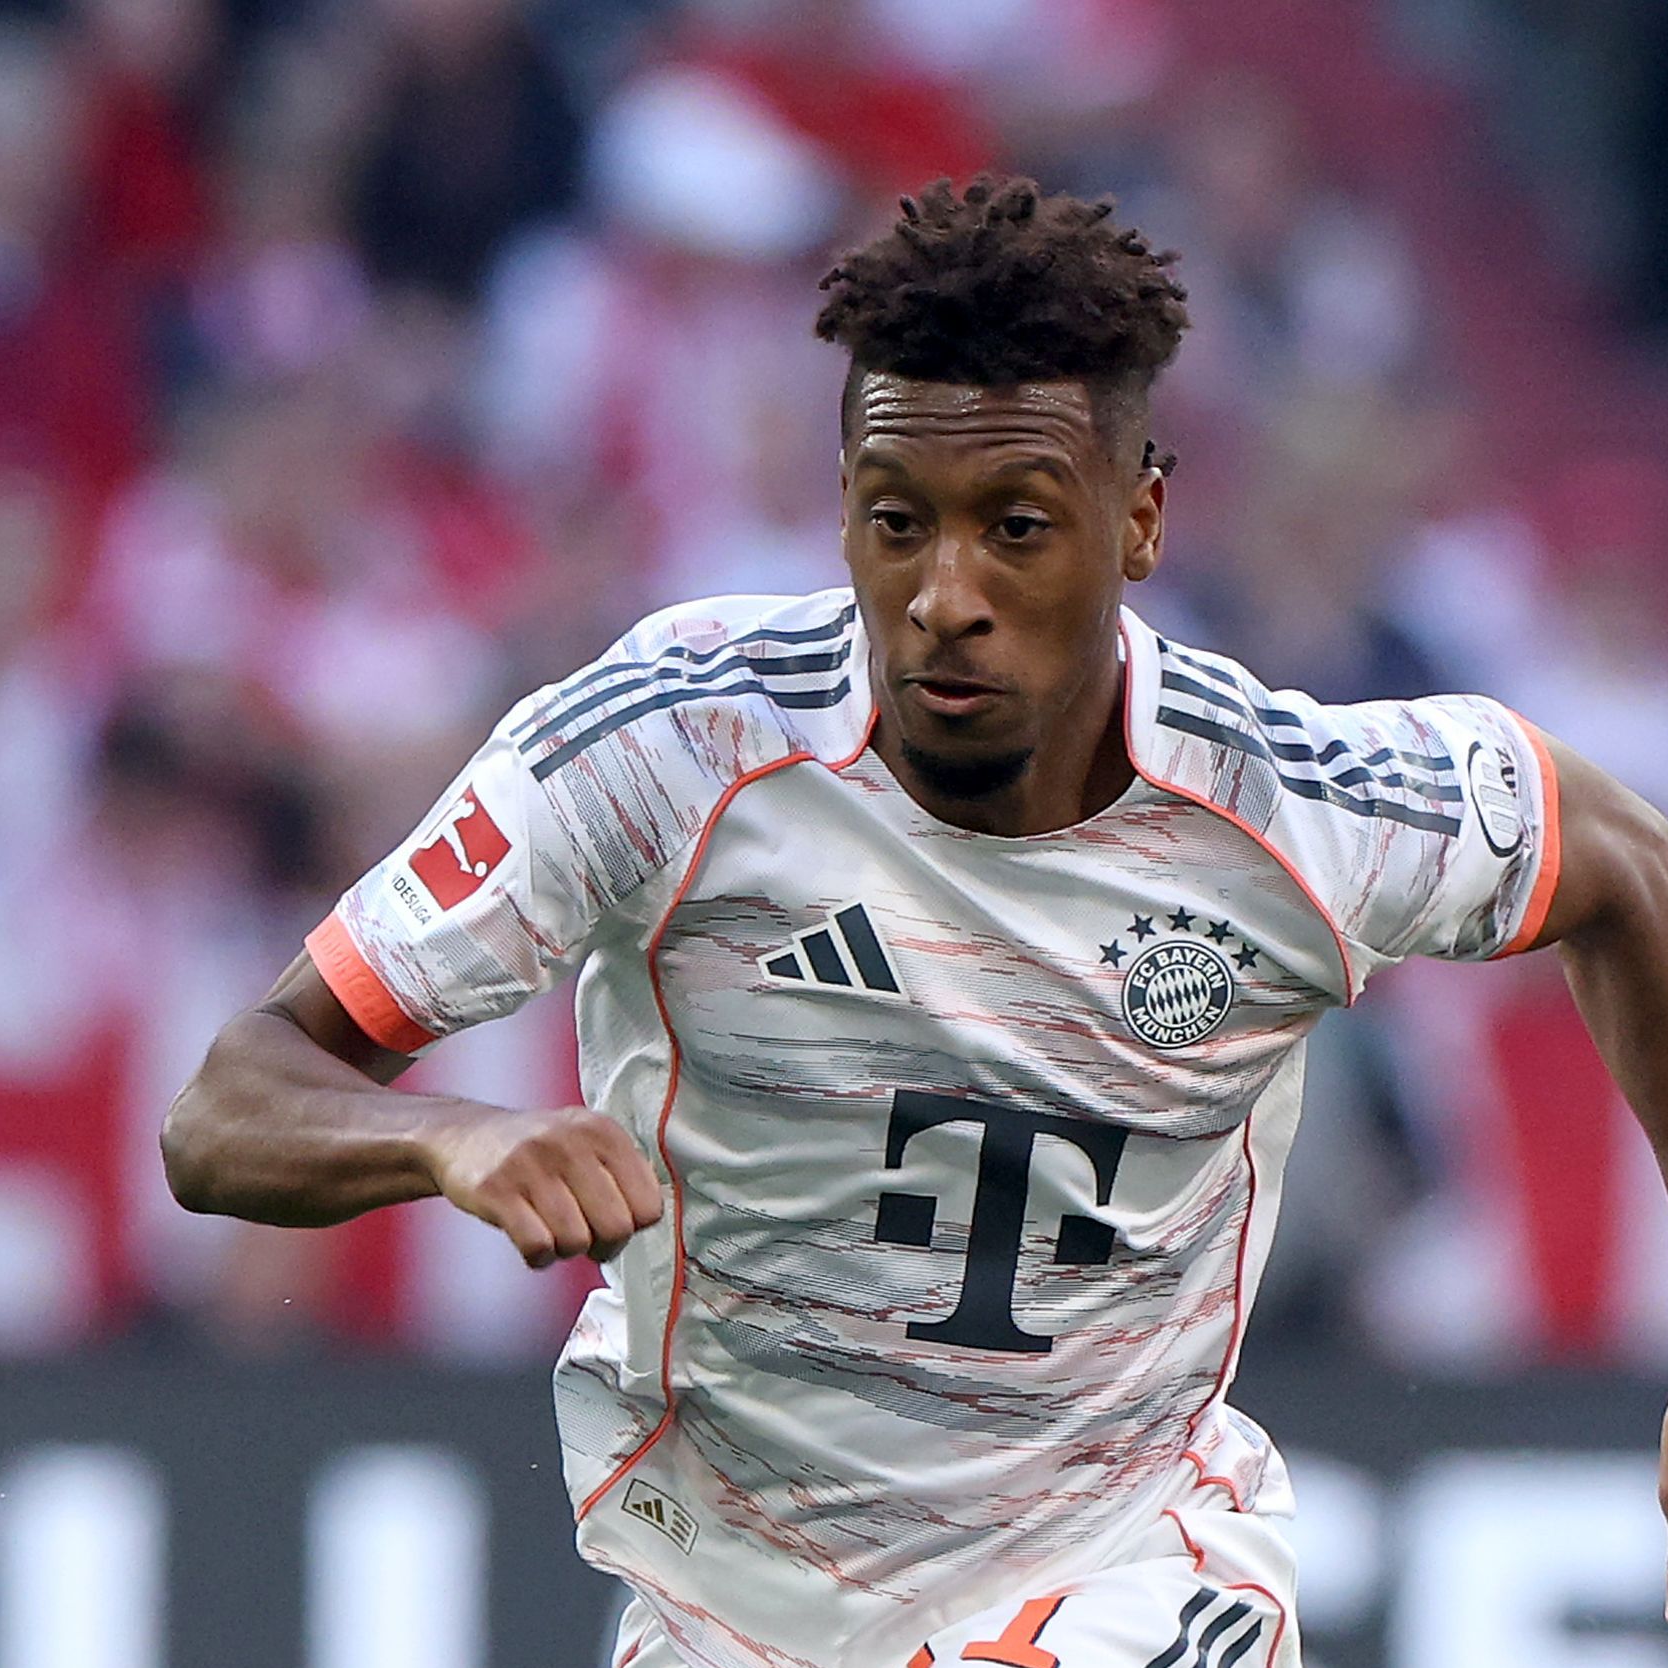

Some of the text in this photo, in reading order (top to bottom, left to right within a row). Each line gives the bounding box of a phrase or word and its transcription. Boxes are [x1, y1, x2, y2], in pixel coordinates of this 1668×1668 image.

[1132, 948, 1226, 990] FC BAYERN
[875, 1089, 1130, 1353] T
